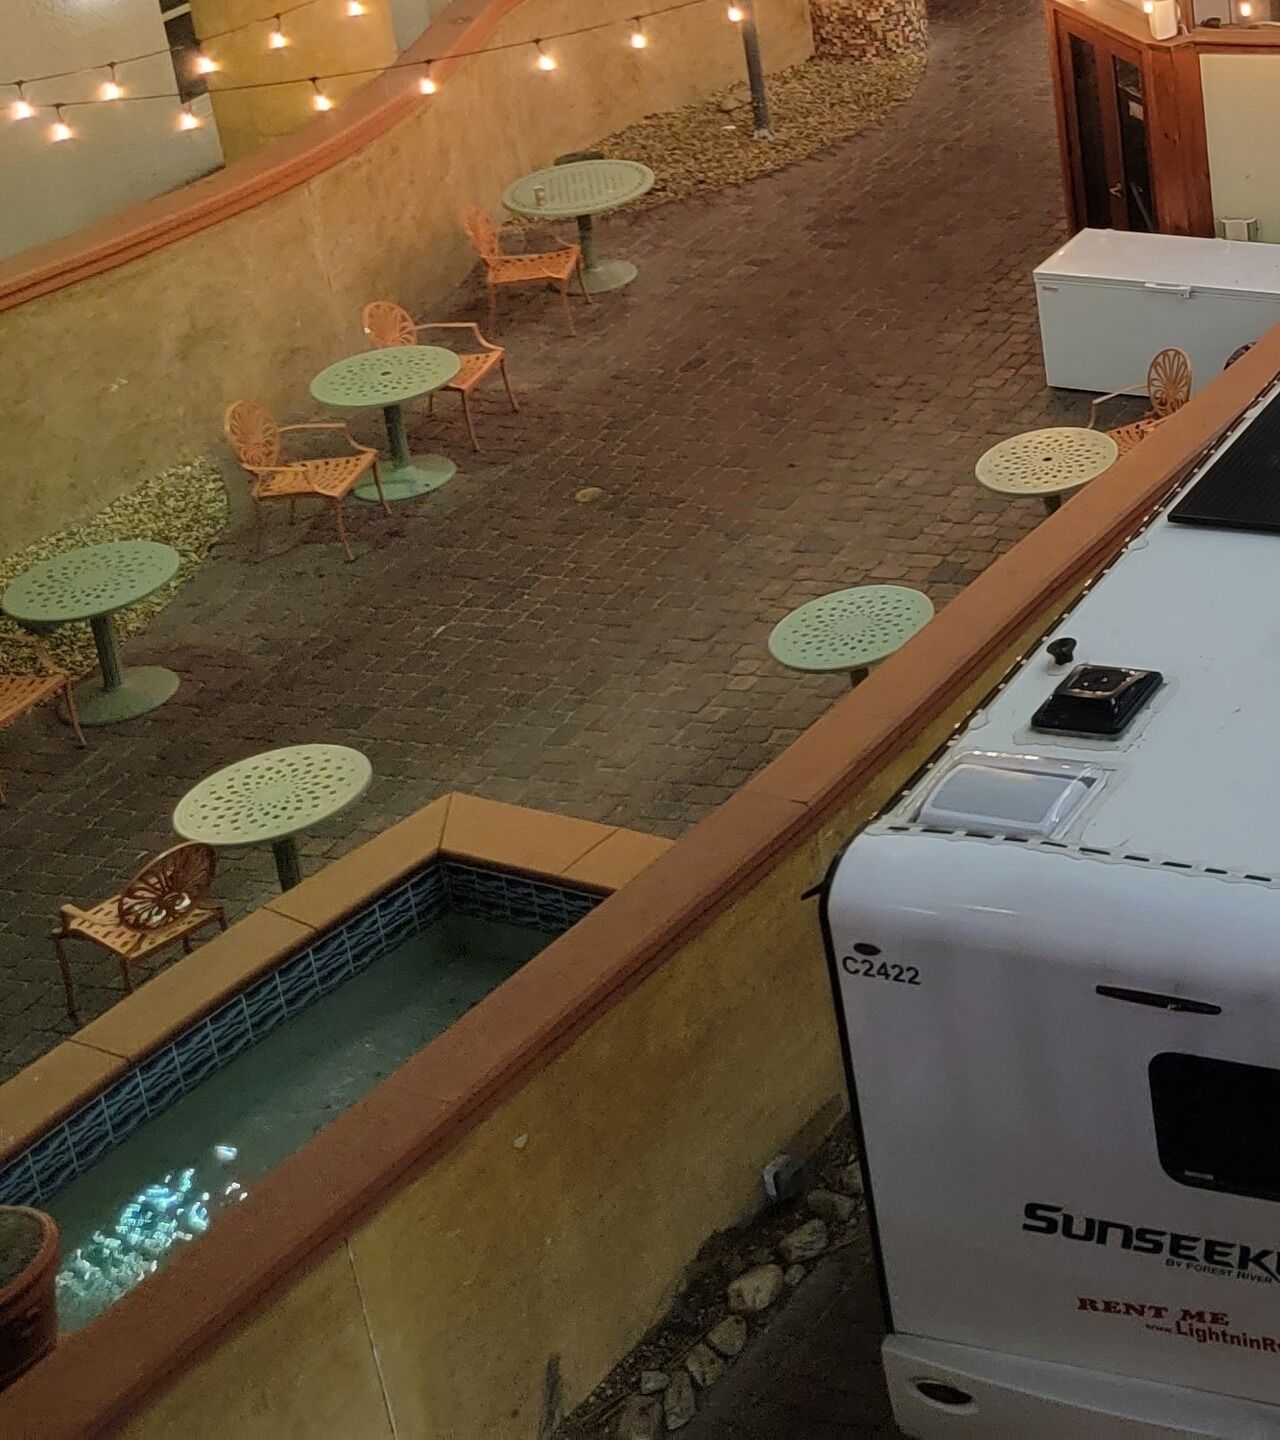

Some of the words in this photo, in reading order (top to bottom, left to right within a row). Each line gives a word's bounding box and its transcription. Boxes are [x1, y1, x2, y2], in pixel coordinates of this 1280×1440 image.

[842, 956, 922, 986] C2422
[1165, 1258, 1183, 1268] BY
[1186, 1262, 1234, 1278] FOREST
[1237, 1272, 1274, 1284] RIVER
[1077, 1297, 1169, 1319] RENT
[1180, 1308, 1231, 1327] ME
